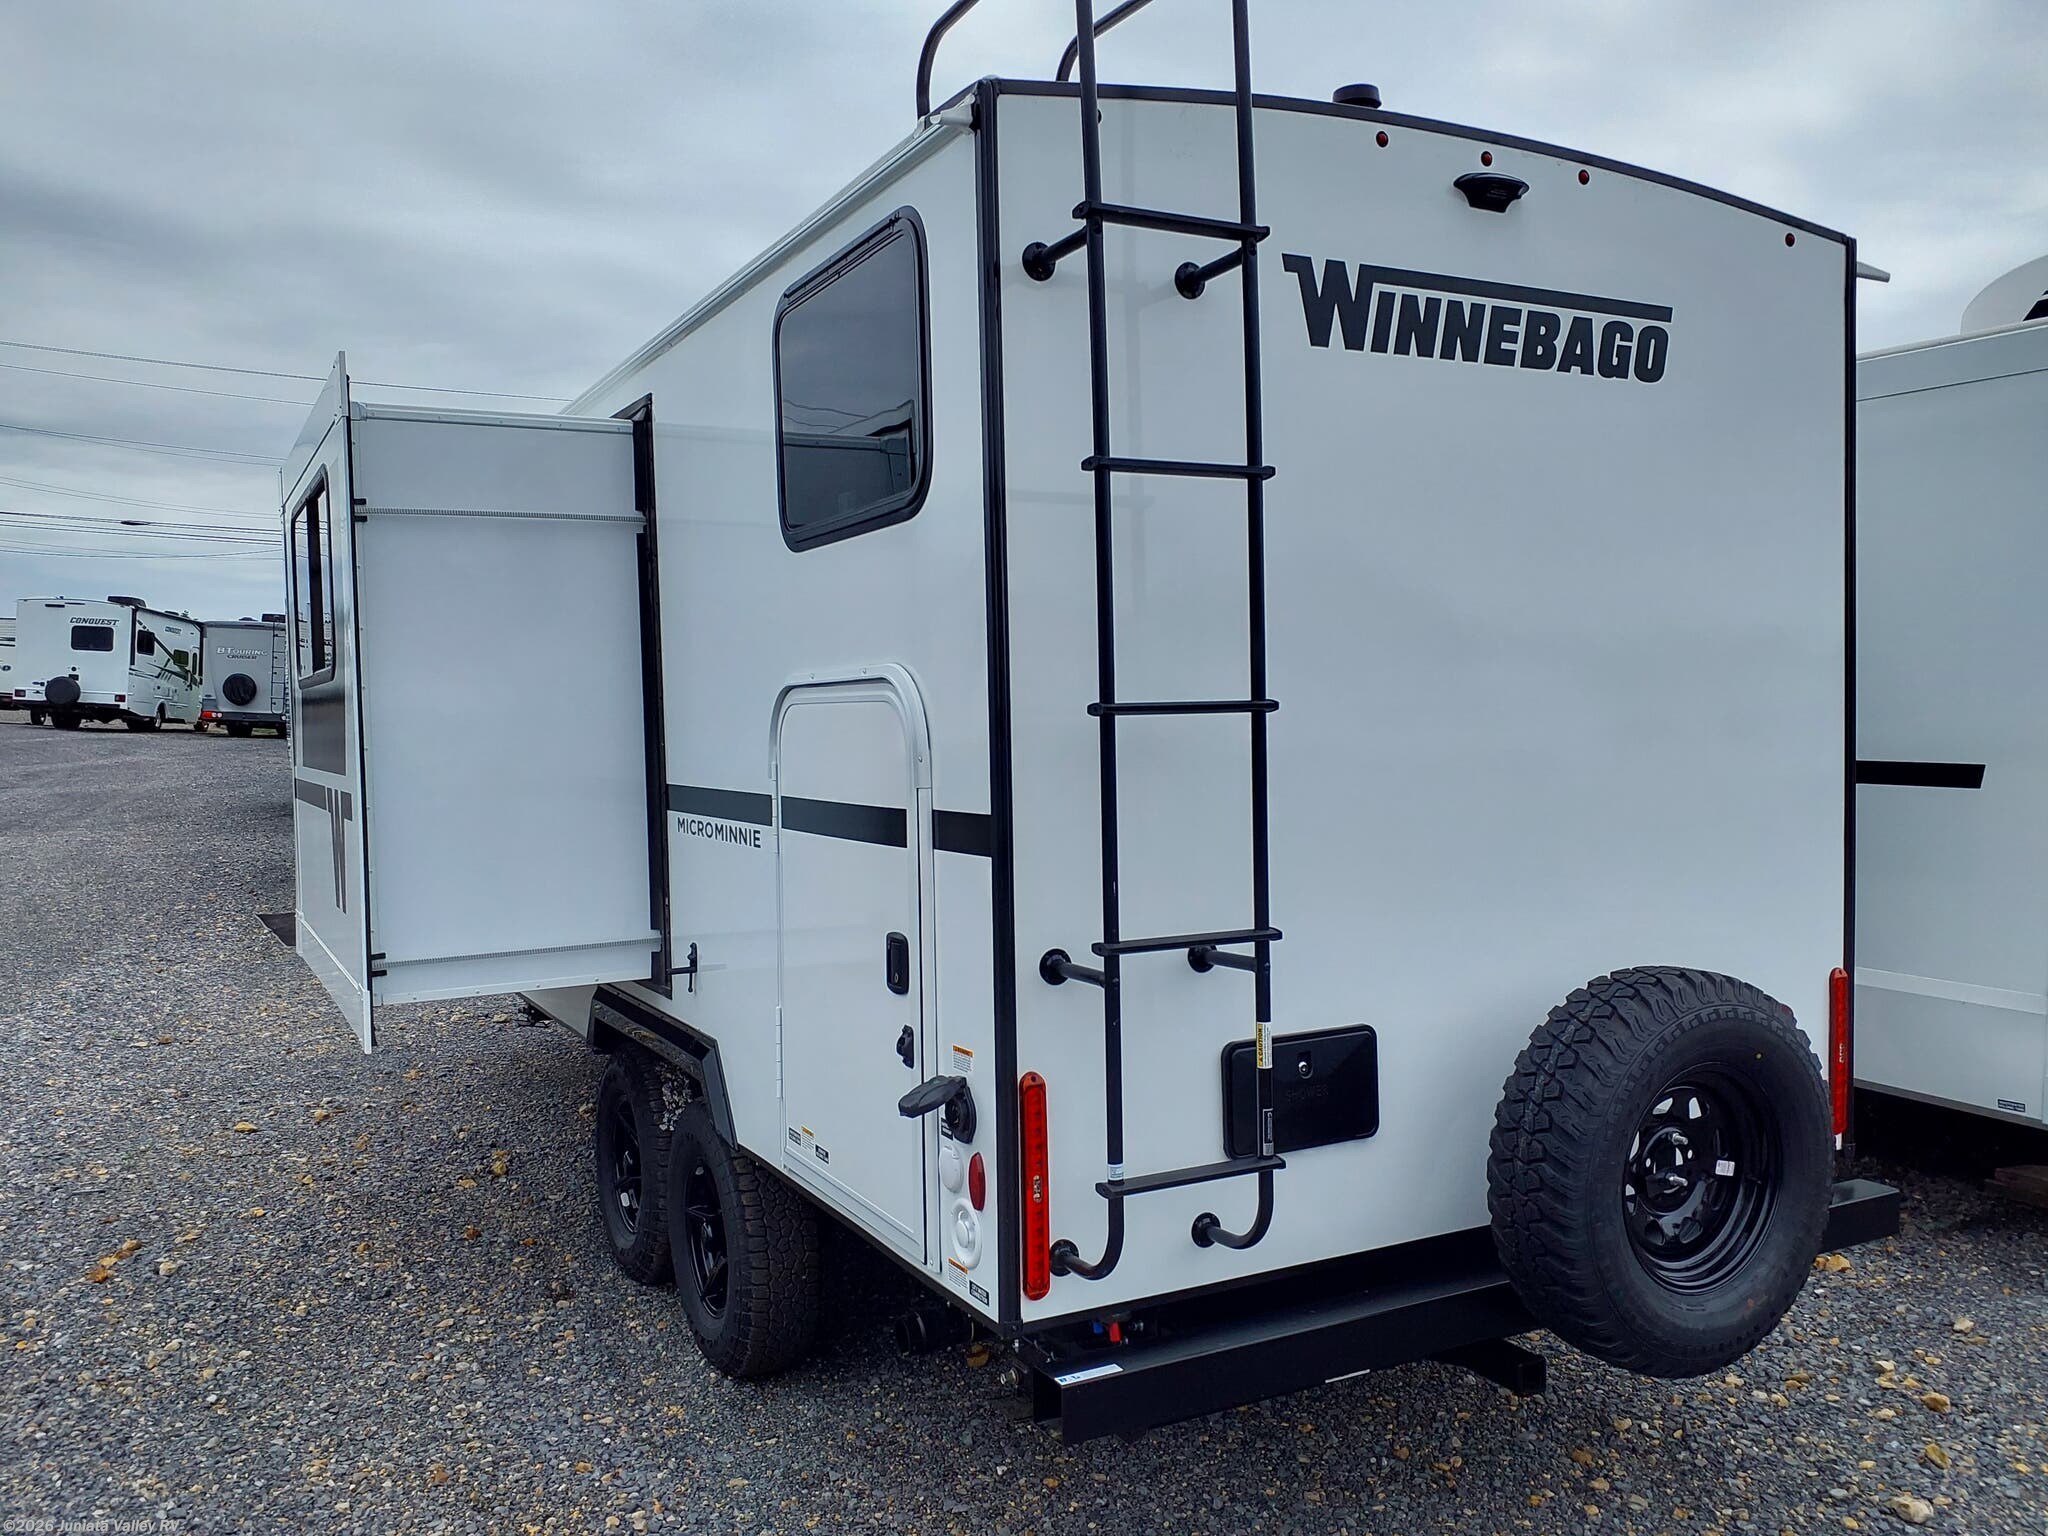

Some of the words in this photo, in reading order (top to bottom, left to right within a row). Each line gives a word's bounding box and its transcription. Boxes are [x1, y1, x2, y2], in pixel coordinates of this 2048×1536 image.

[1282, 253, 1673, 384] WINNEBAGO
[70, 617, 119, 626] CONQUEST
[677, 817, 762, 849] MICROMINNIE
